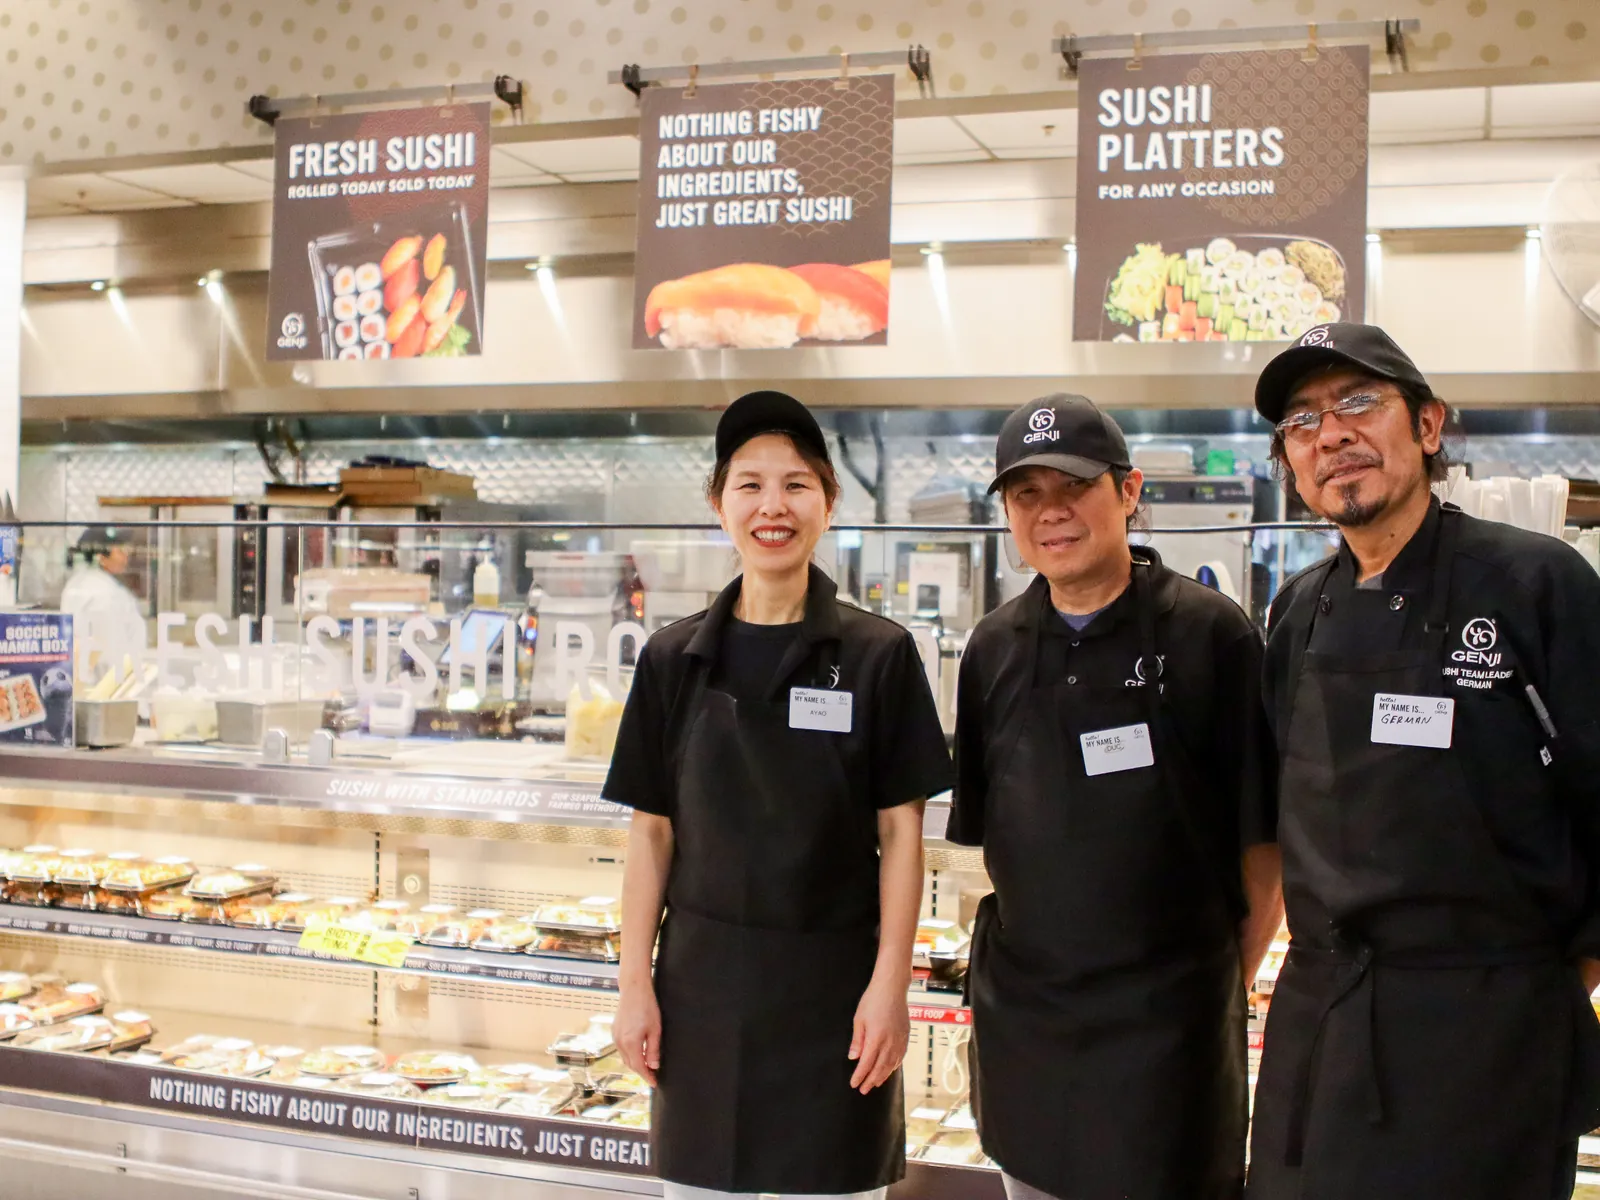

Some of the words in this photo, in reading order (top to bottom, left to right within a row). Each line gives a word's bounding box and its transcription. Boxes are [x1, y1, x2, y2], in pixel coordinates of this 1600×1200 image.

[1097, 84, 1212, 128] SUSHI
[659, 110, 754, 139] NOTHING
[758, 107, 823, 133] FISHY
[288, 139, 378, 179] FRESH
[385, 132, 475, 172] SUSHI
[657, 142, 728, 169] ABOUT
[732, 139, 777, 165] OUR
[1097, 126, 1285, 172] PLATTERS
[288, 183, 339, 199] ROLLED
[341, 180, 386, 195] TODAY
[388, 177, 425, 192] SOLD
[427, 174, 475, 190] TODAY
[657, 168, 805, 198] INGREDIENTS,
[1098, 184, 1134, 200] FOR
[1138, 182, 1176, 198] ANY
[1180, 180, 1275, 197] OCCASION
[655, 202, 708, 228] JUST
[713, 199, 781, 226] GREAT
[785, 196, 853, 223] SUSHI
[1023, 430, 1060, 444] GENJI
[305, 615, 516, 700] SUSHI
[555, 620, 649, 702] RO
[1451, 650, 1502, 667] GENJI
[1442, 667, 1459, 676] USHI
[1460, 668, 1485, 679] TEAM
[1456, 678, 1492, 689] GERMAN
[1379, 703, 1389, 711] MY
[1391, 703, 1410, 713] NAME
[1381, 713, 1432, 724] GERMAN
[1086, 740, 1095, 748] MY
[1096, 738, 1113, 746] NAME
[326, 779, 380, 798] SUSHI
[385, 782, 431, 801] WITH
[433, 786, 542, 808] STANDARDS
[909, 1008, 923, 1018] EET
[150, 1077, 226, 1109] NOTHING
[230, 1088, 283, 1118] FISHY
[286, 1097, 347, 1126] ABOUT
[351, 1107, 390, 1133] OUR
[395, 1113, 528, 1155] INGREDIENTS,
[533, 1130, 584, 1158] JUST
[590, 1136, 650, 1167] GREAT
